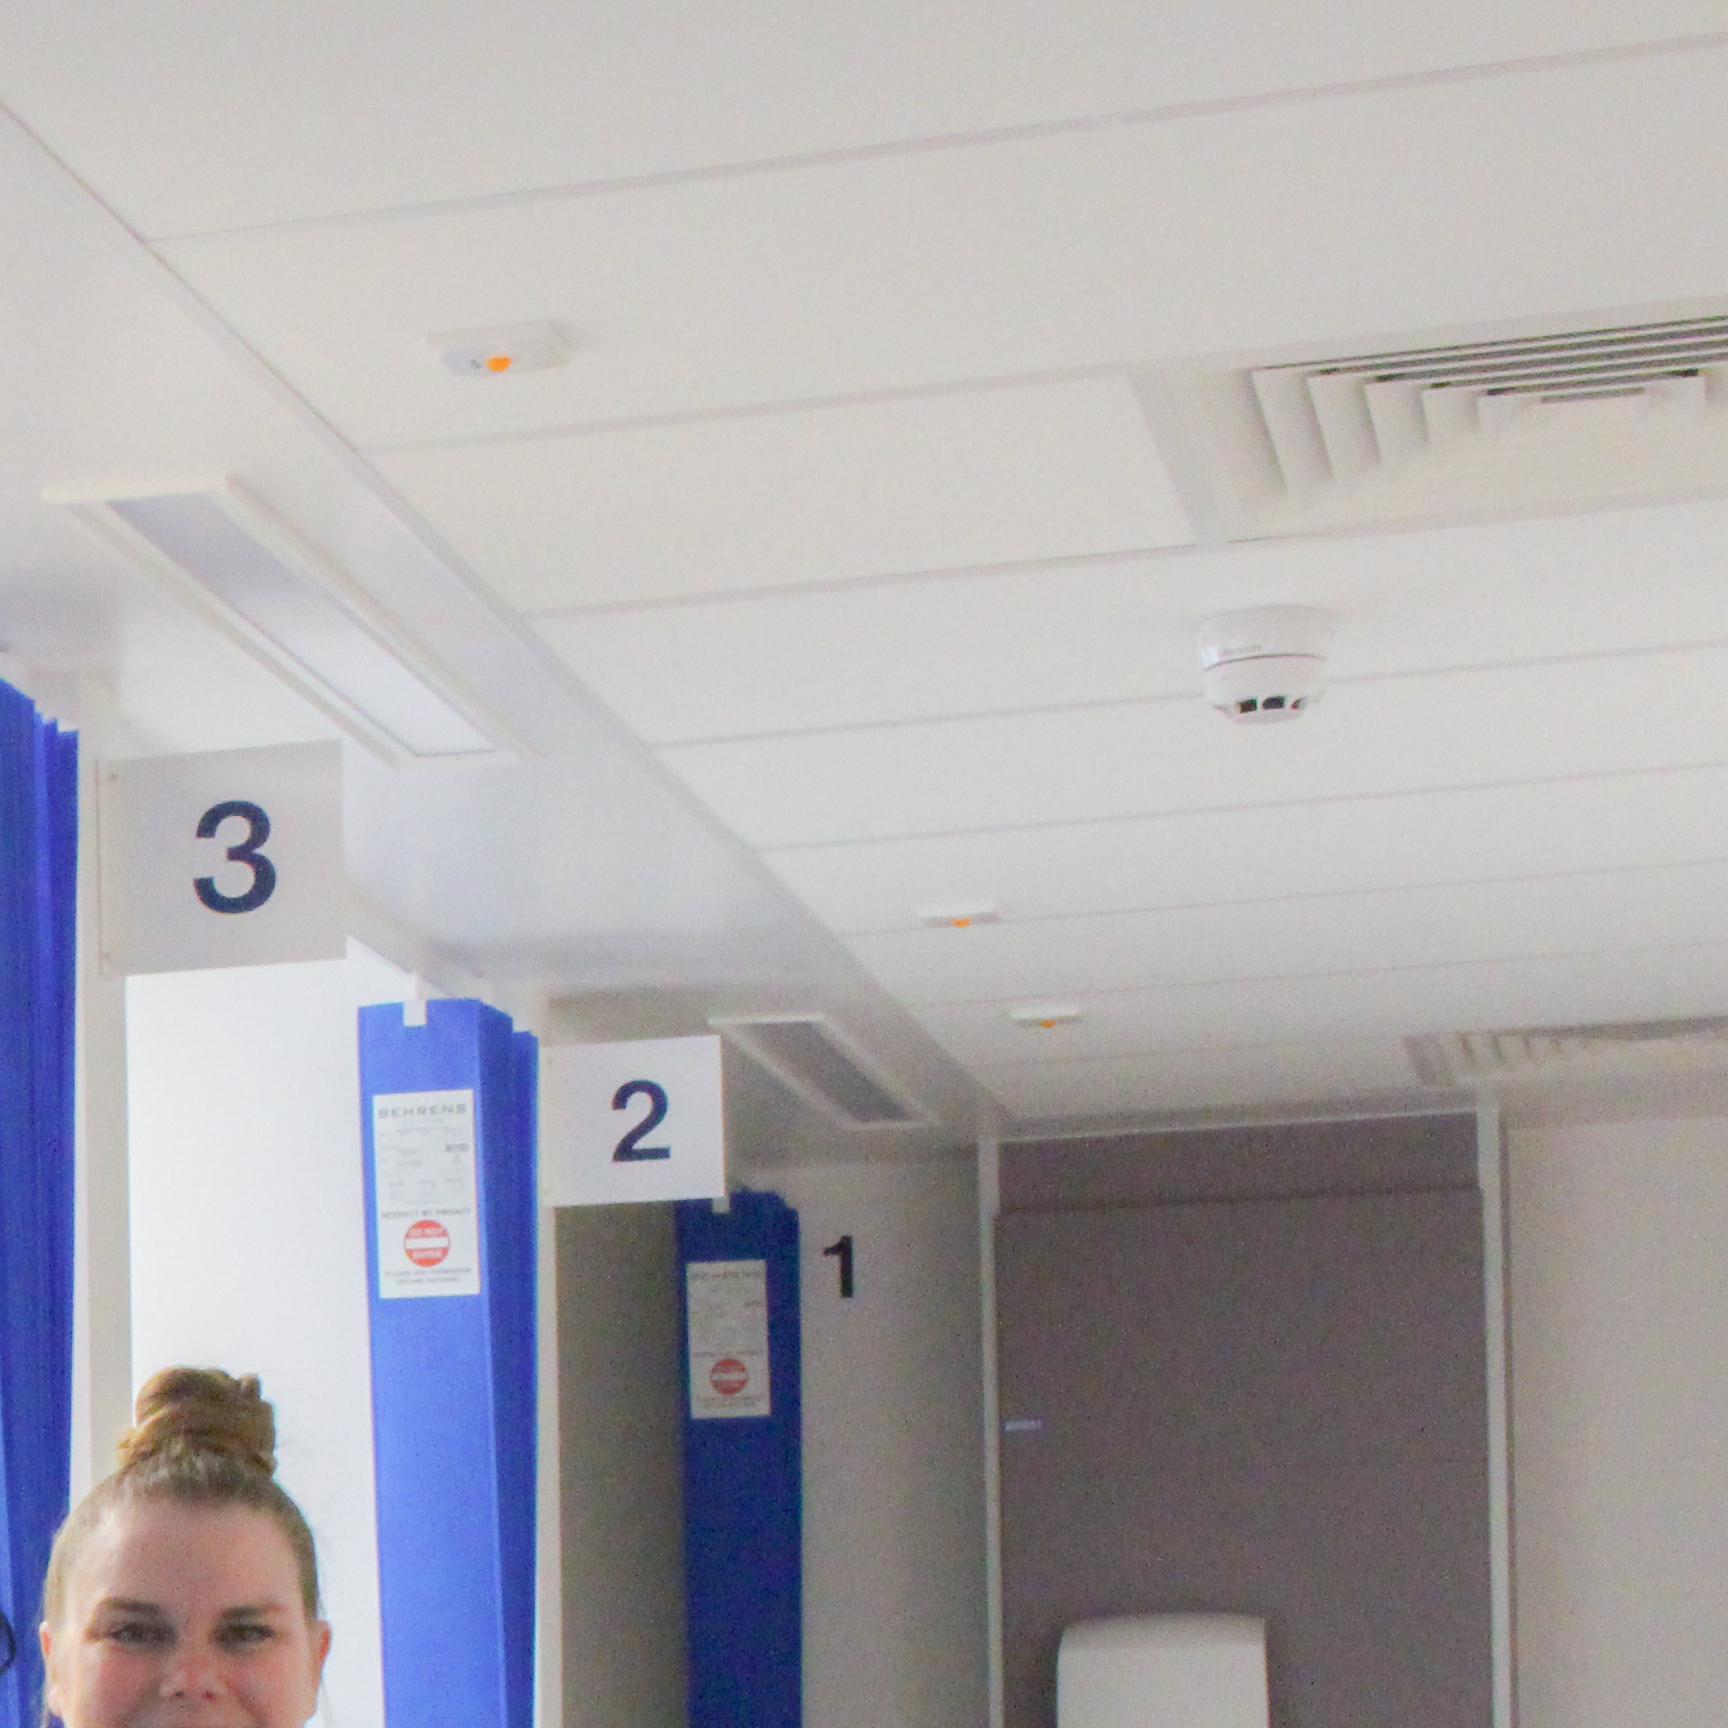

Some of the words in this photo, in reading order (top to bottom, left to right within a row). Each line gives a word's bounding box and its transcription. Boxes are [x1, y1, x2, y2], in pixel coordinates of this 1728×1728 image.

[193, 799, 277, 915] 3
[378, 1103, 468, 1119] BEHRENS
[611, 1078, 671, 1163] 2
[823, 1234, 854, 1299] 1
